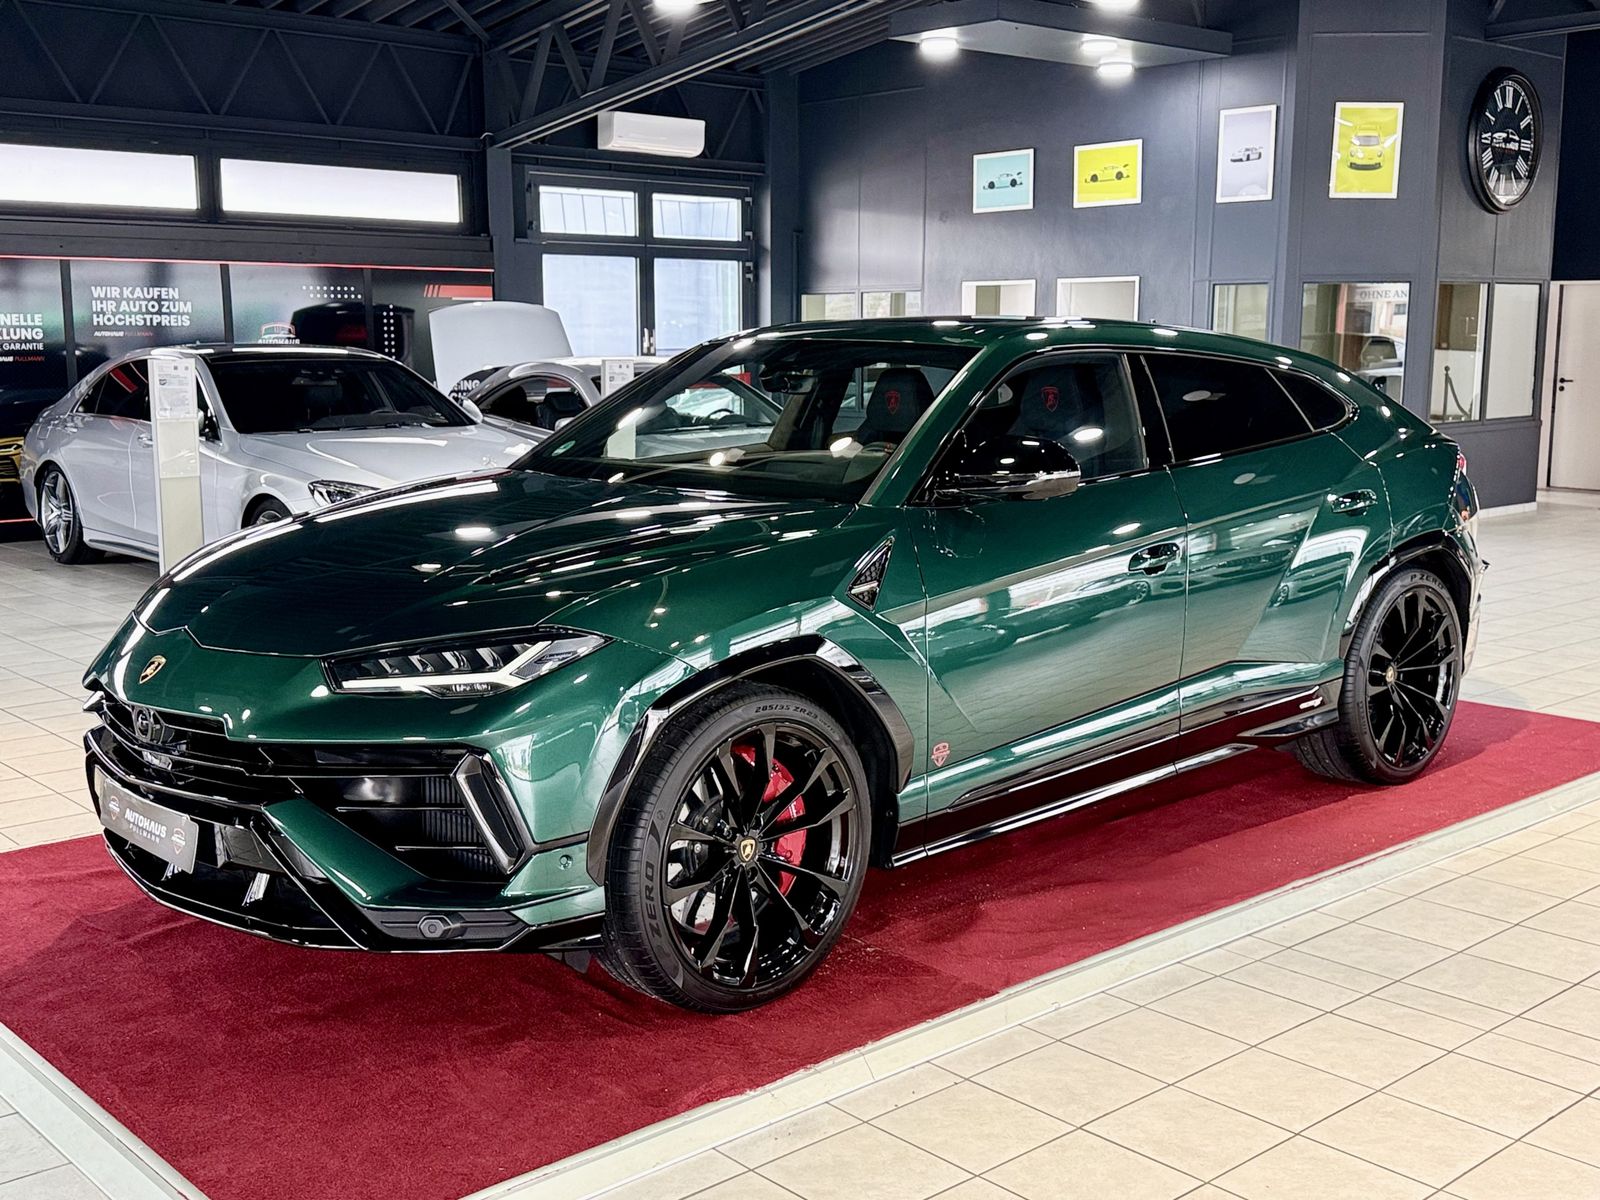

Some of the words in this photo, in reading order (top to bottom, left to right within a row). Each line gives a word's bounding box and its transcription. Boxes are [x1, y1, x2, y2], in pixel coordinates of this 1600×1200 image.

[91, 286, 120, 299] WIR
[122, 287, 180, 300] KAUFEN
[1359, 290, 1391, 300] OHNE
[92, 300, 117, 313] IHR
[119, 301, 159, 313] AUTO
[161, 302, 192, 314] ZUM
[0, 314, 43, 326] NELLE
[93, 311, 191, 327] HÖCHSTPREIS
[2, 342, 44, 351] GARANTIE
[124, 808, 167, 838] AUTOHAUS
[129, 823, 159, 844] PULLMANN
[644, 860, 662, 939] ZERO
